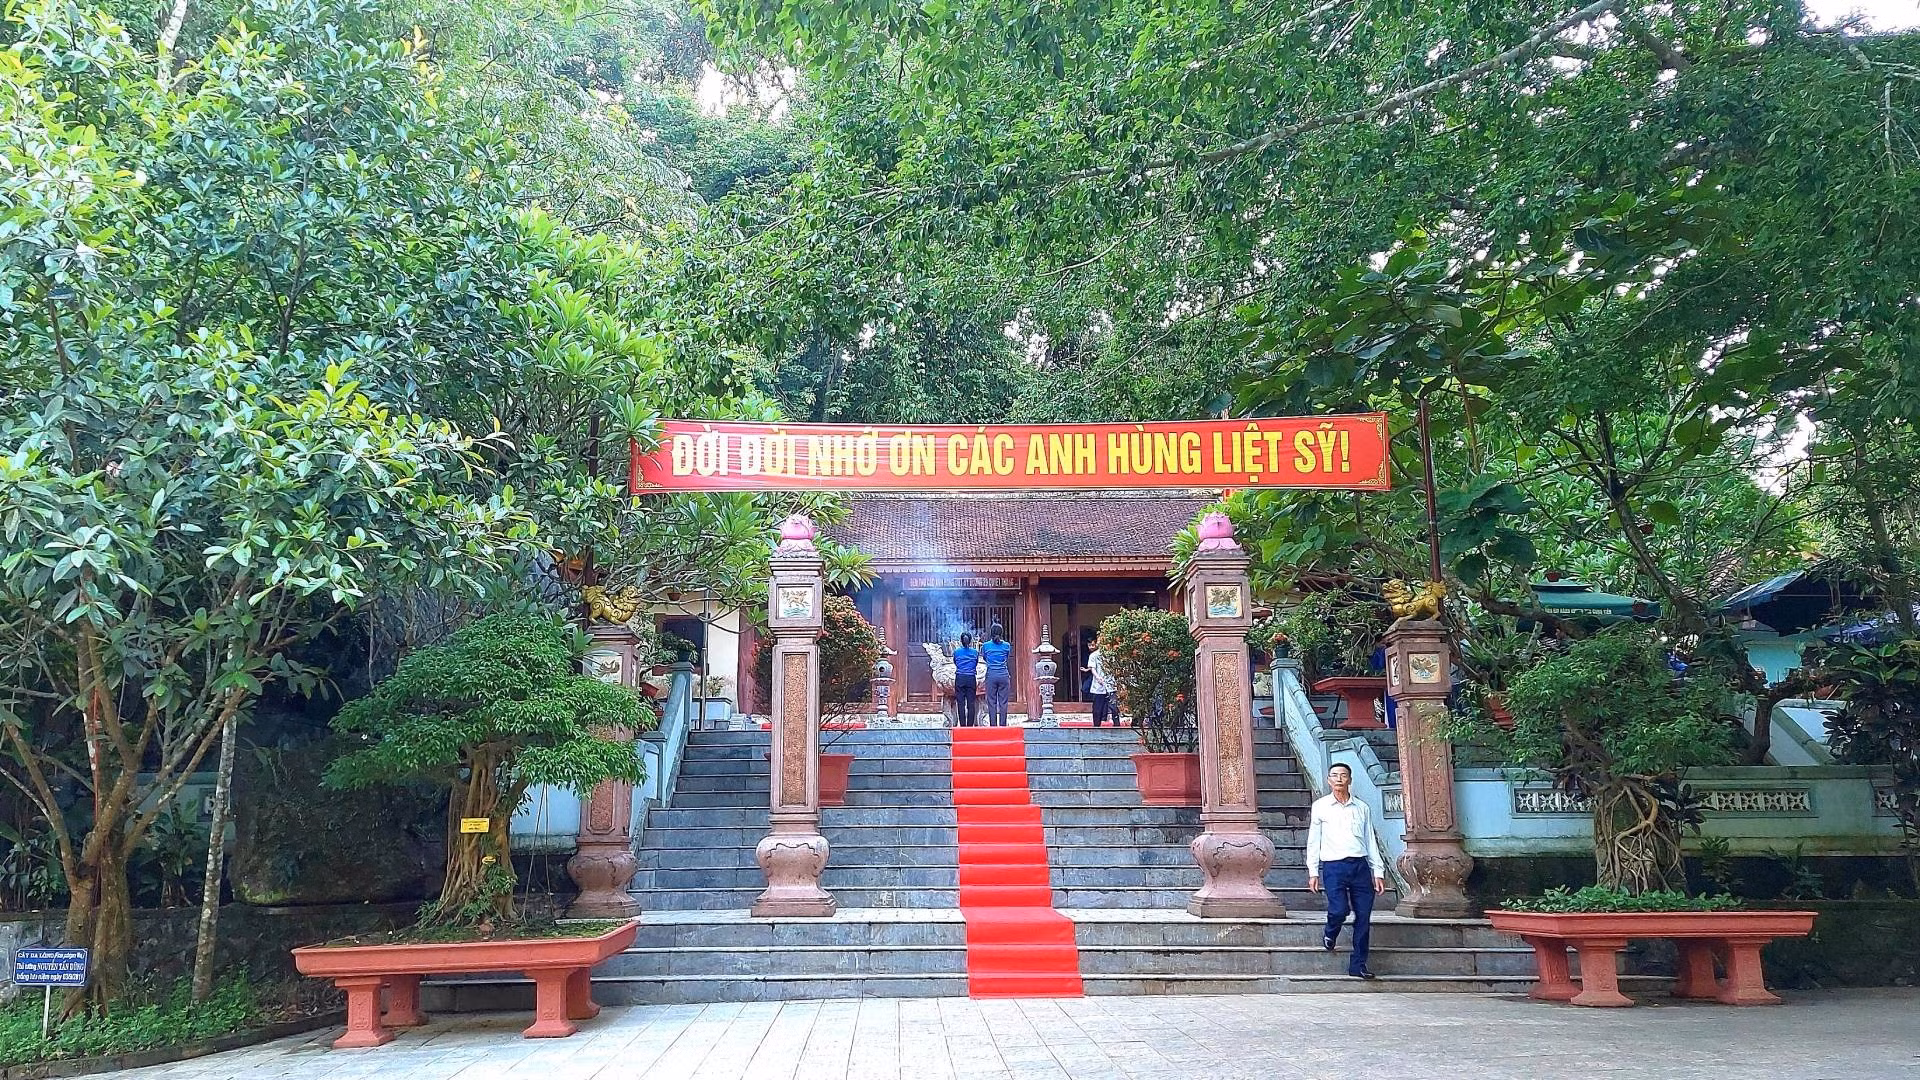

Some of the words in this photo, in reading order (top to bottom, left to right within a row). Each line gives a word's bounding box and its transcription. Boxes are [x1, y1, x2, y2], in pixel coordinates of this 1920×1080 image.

[671, 423, 729, 476] ĐỜI
[739, 426, 797, 476] ĐỜI
[807, 426, 879, 476] NHỚ
[889, 430, 937, 476] ƠN
[947, 426, 1016, 476] CÁC
[1025, 432, 1097, 475] ANH
[1106, 425, 1202, 475] HÙNG
[1213, 423, 1283, 483] LIỆT
[1294, 422, 1350, 473] SỸ!
